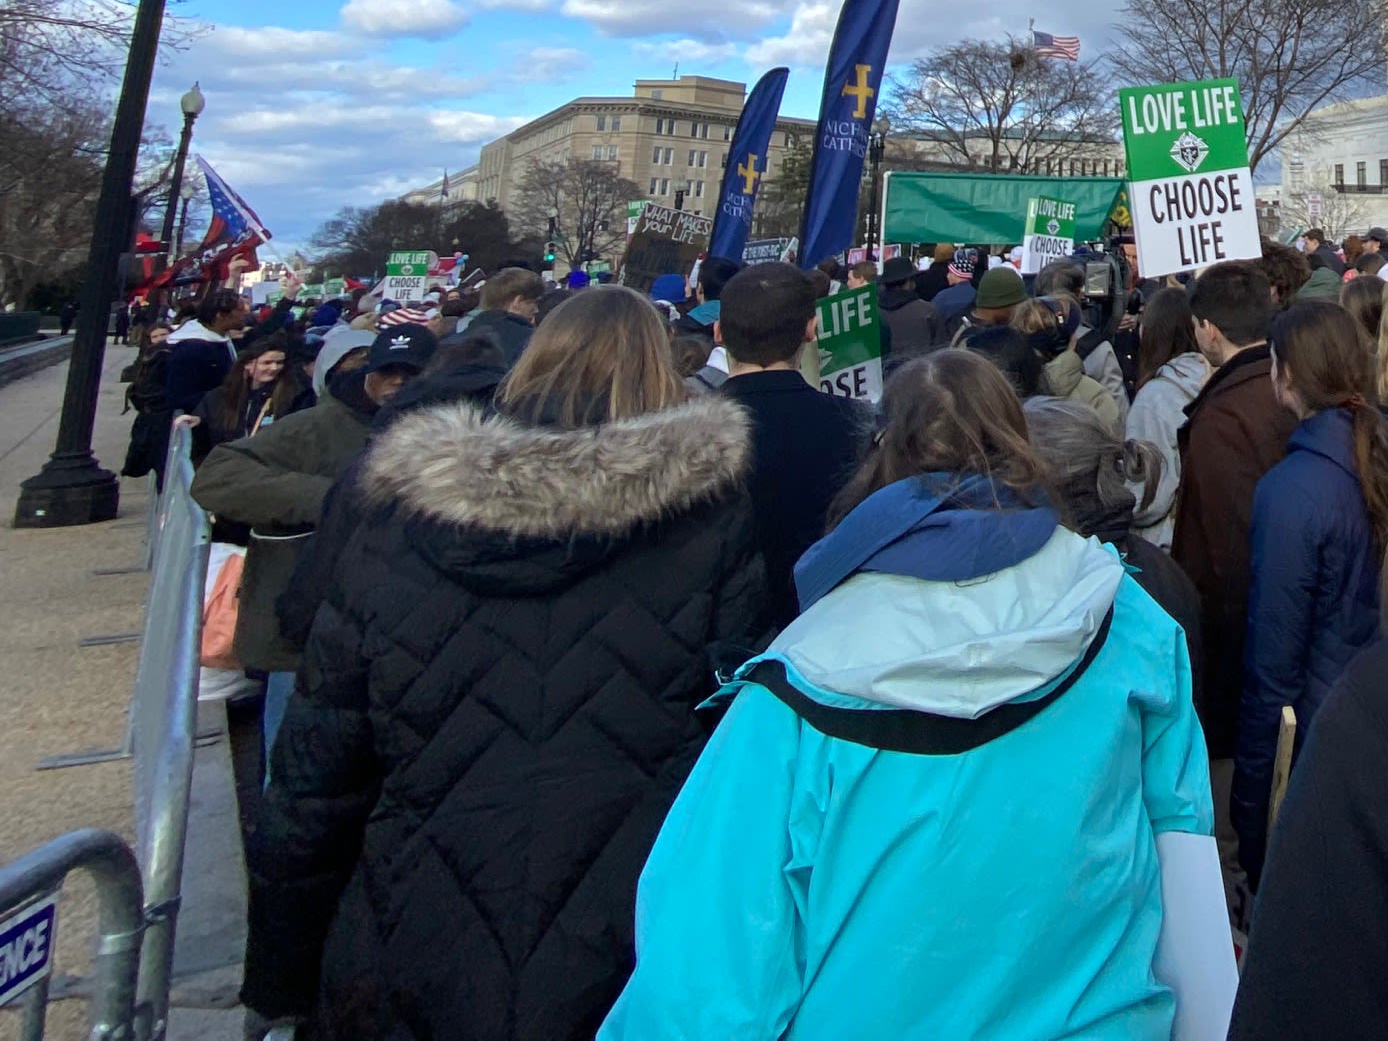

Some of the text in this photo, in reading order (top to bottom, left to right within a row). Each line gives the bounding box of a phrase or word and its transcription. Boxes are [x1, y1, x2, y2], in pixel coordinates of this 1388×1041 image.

[1129, 86, 1238, 135] LOVE LIFE
[1038, 199, 1058, 217] LOVE
[1057, 202, 1075, 221] LIFE
[1150, 174, 1242, 224] CHOOSE
[642, 221, 672, 234] your
[671, 226, 696, 244] LIFE
[644, 204, 711, 235] WHAT MAKES
[1035, 236, 1068, 256] CHOOSE
[1177, 221, 1226, 266] LIFE
[390, 253, 428, 264] LOVE LIFE
[389, 277, 421, 288] CHOOSE
[395, 289, 412, 299] LIFE
[816, 292, 872, 340] LIFE
[820, 367, 868, 399] OSE
